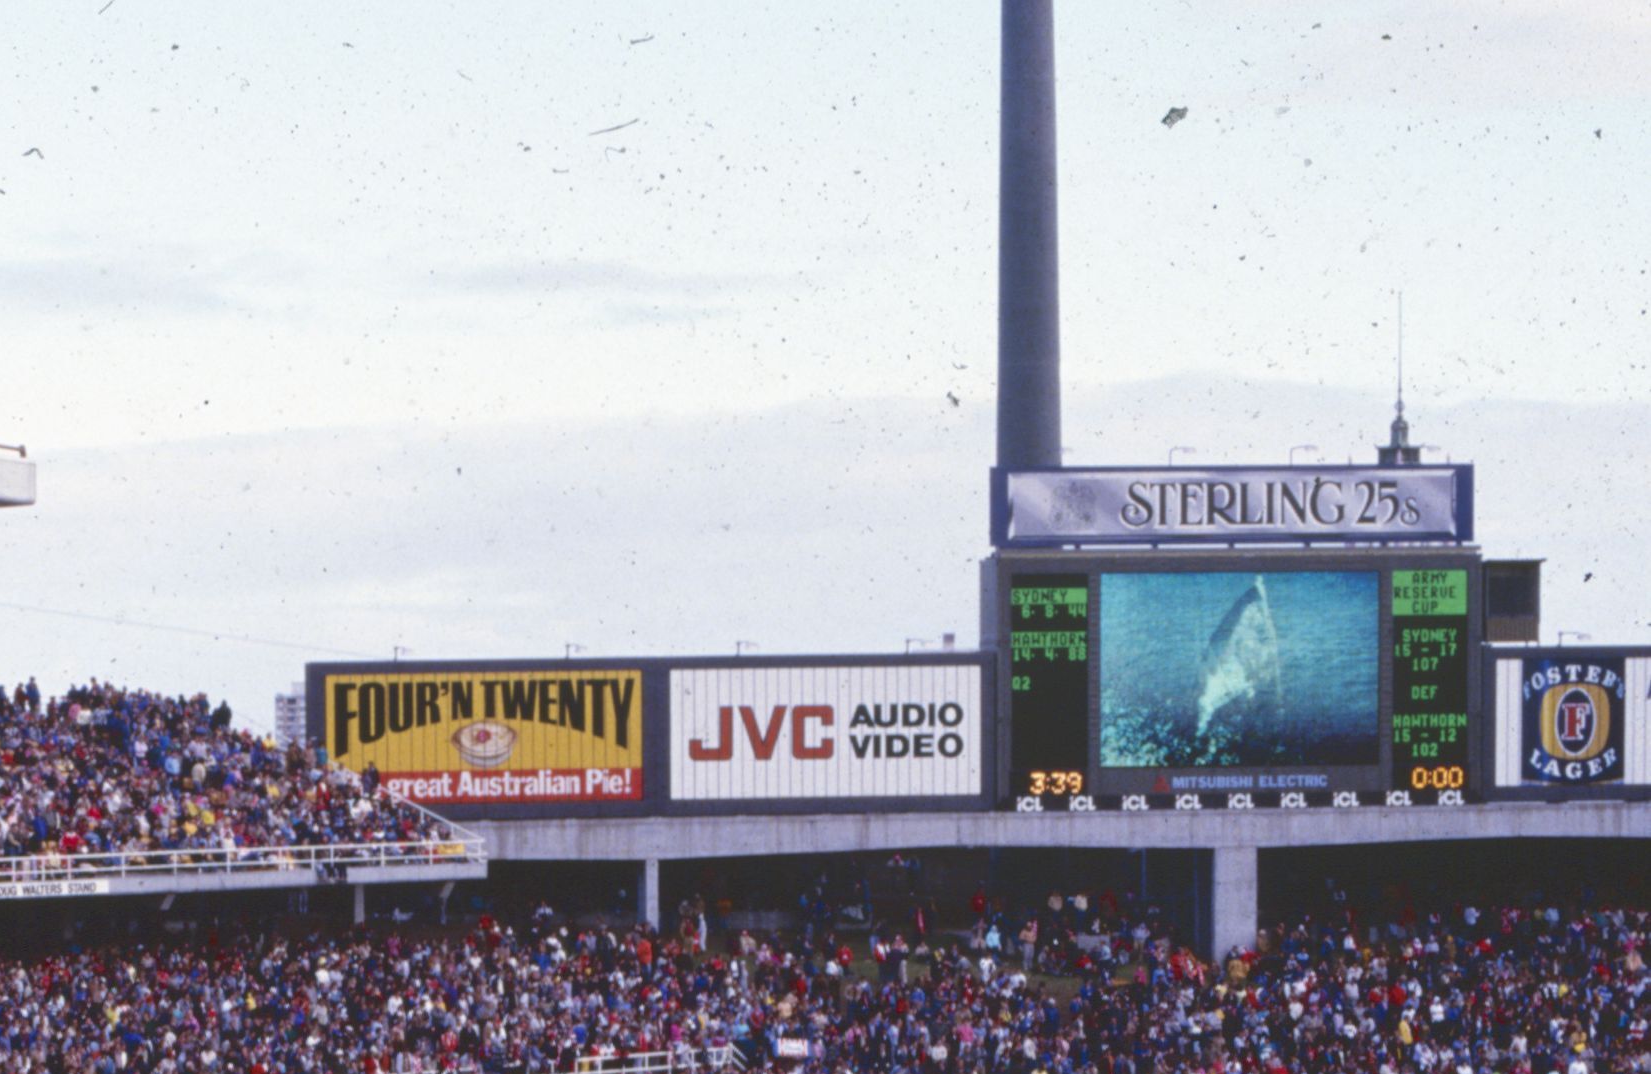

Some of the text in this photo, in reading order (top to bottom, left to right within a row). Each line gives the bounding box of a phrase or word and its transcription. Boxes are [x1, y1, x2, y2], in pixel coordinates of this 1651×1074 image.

[1120, 476, 1421, 527] STERLING 25s
[1413, 572, 1447, 584] ARMY
[1013, 589, 1068, 604] SYDNEY
[1394, 586, 1456, 599] RESERVE
[1413, 601, 1438, 613] CUP
[1012, 632, 1087, 647] HAWTHORN
[1402, 629, 1457, 642] SYDNEY
[1440, 643, 1457, 656] 17
[1413, 657, 1438, 671] 107
[1411, 686, 1438, 699] DEF
[334, 678, 635, 759] FOUR'N TWENTY
[849, 703, 964, 728] AUDIO
[1392, 713, 1467, 728] HAWTHORN
[1562, 703, 1591, 740] F
[689, 704, 834, 761] JVC
[1440, 729, 1457, 742] 12
[849, 733, 964, 759] VIDEO
[1412, 743, 1438, 757] 102
[1530, 748, 1617, 780] LAGER
[387, 768, 632, 803] great Australian Pie!
[1030, 771, 1083, 795] 3:39
[1172, 774, 1328, 788] MITSUBISHI ELECTRIC
[1412, 767, 1463, 789] 0:00
[23, 884, 62, 895] WALTERS
[68, 883, 96, 893] STAND
